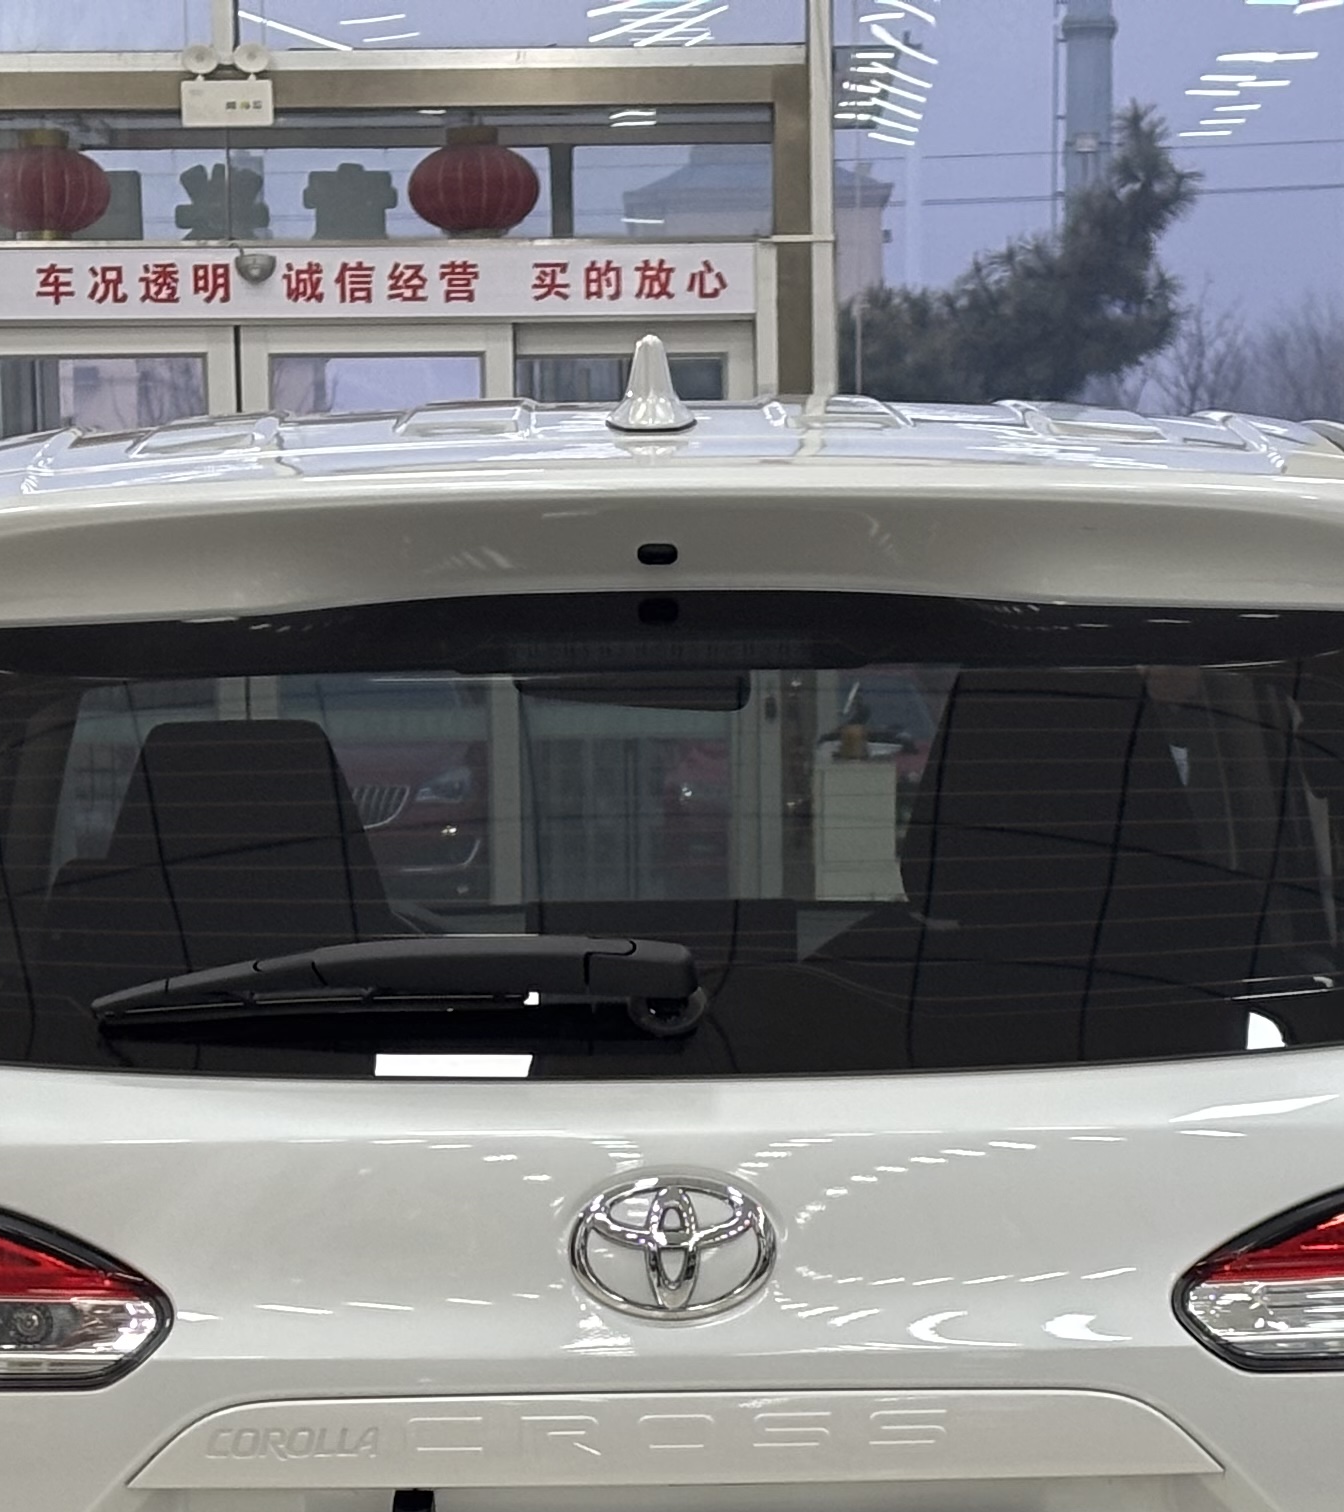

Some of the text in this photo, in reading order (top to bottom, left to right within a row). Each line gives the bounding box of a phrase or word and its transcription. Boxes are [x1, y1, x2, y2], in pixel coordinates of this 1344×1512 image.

[35, 263, 233, 305] 车况透明
[282, 261, 482, 303] 诚信经营
[531, 259, 729, 301] 买的放心
[205, 1408, 948, 1461] COROLLA CROSS
